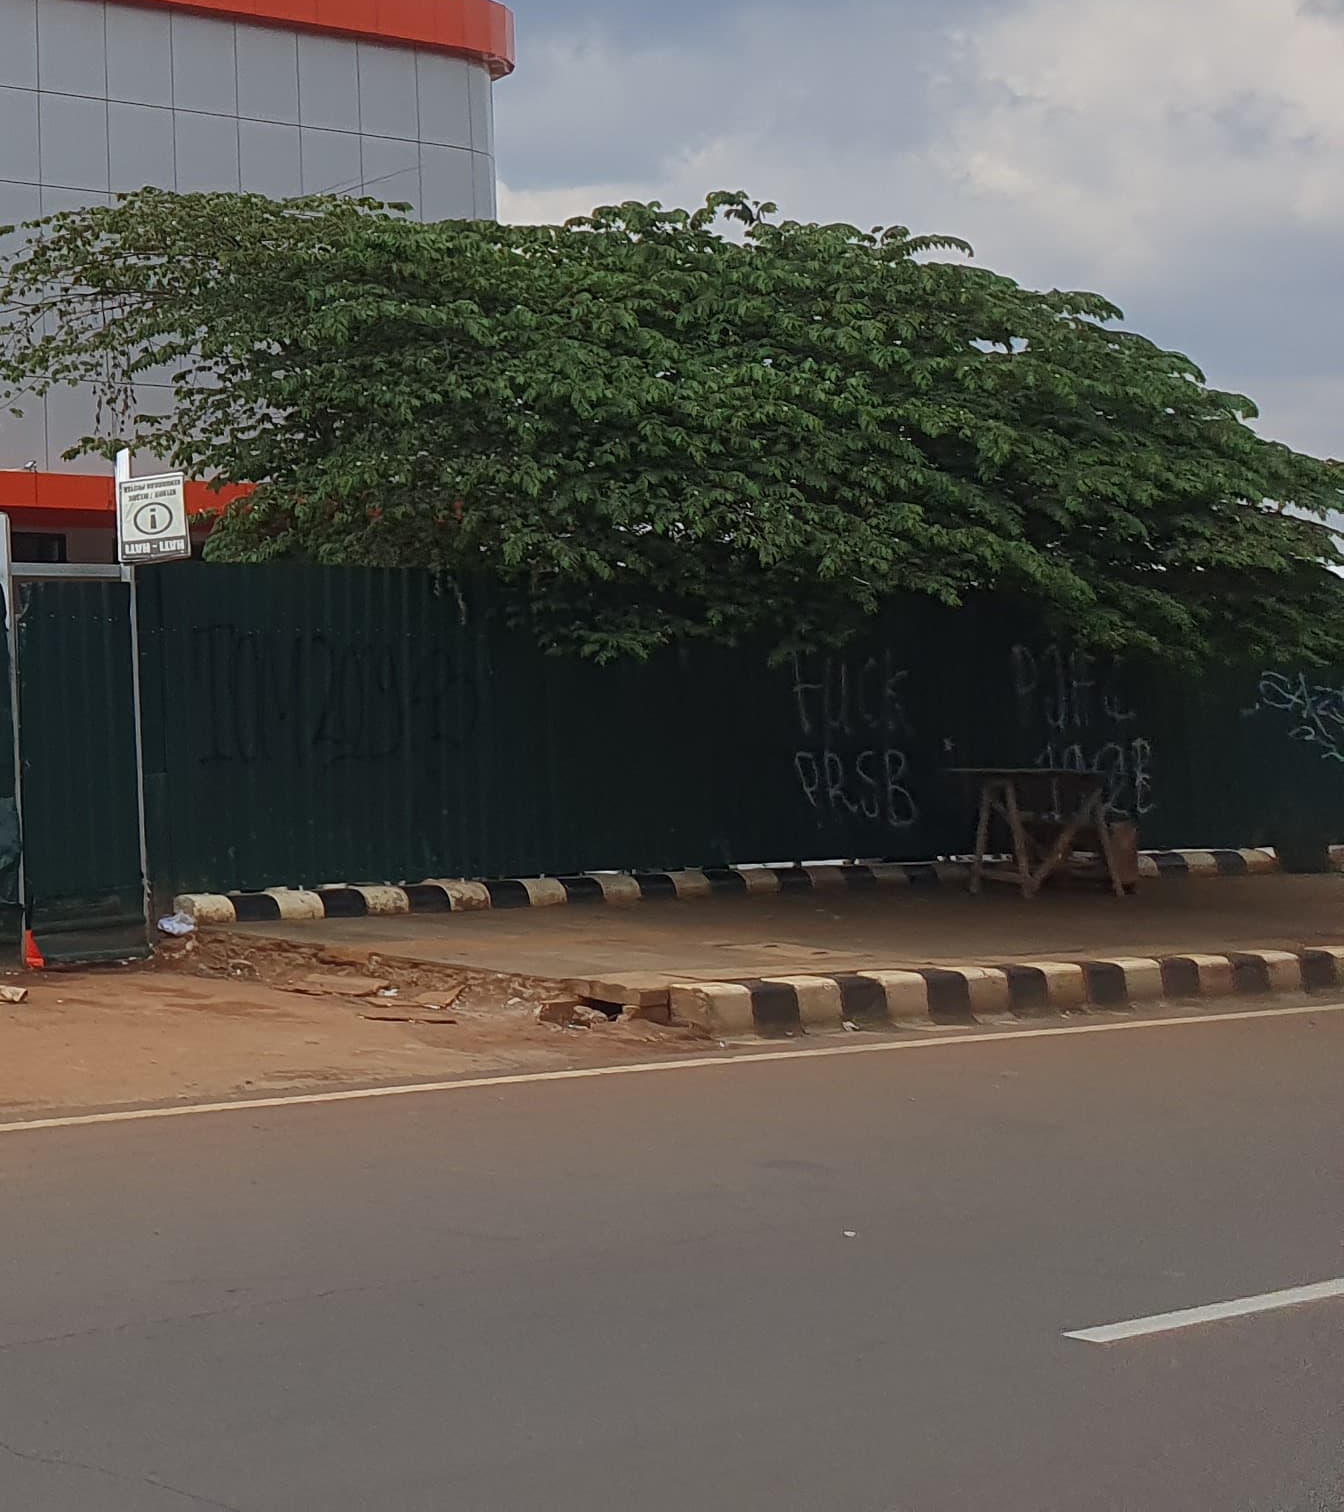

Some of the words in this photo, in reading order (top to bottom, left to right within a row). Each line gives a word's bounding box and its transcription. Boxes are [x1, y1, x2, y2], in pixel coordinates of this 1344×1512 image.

[125, 542, 150, 555] HATI
[159, 539, 185, 552] HATI
[792, 648, 914, 735] FUCK
